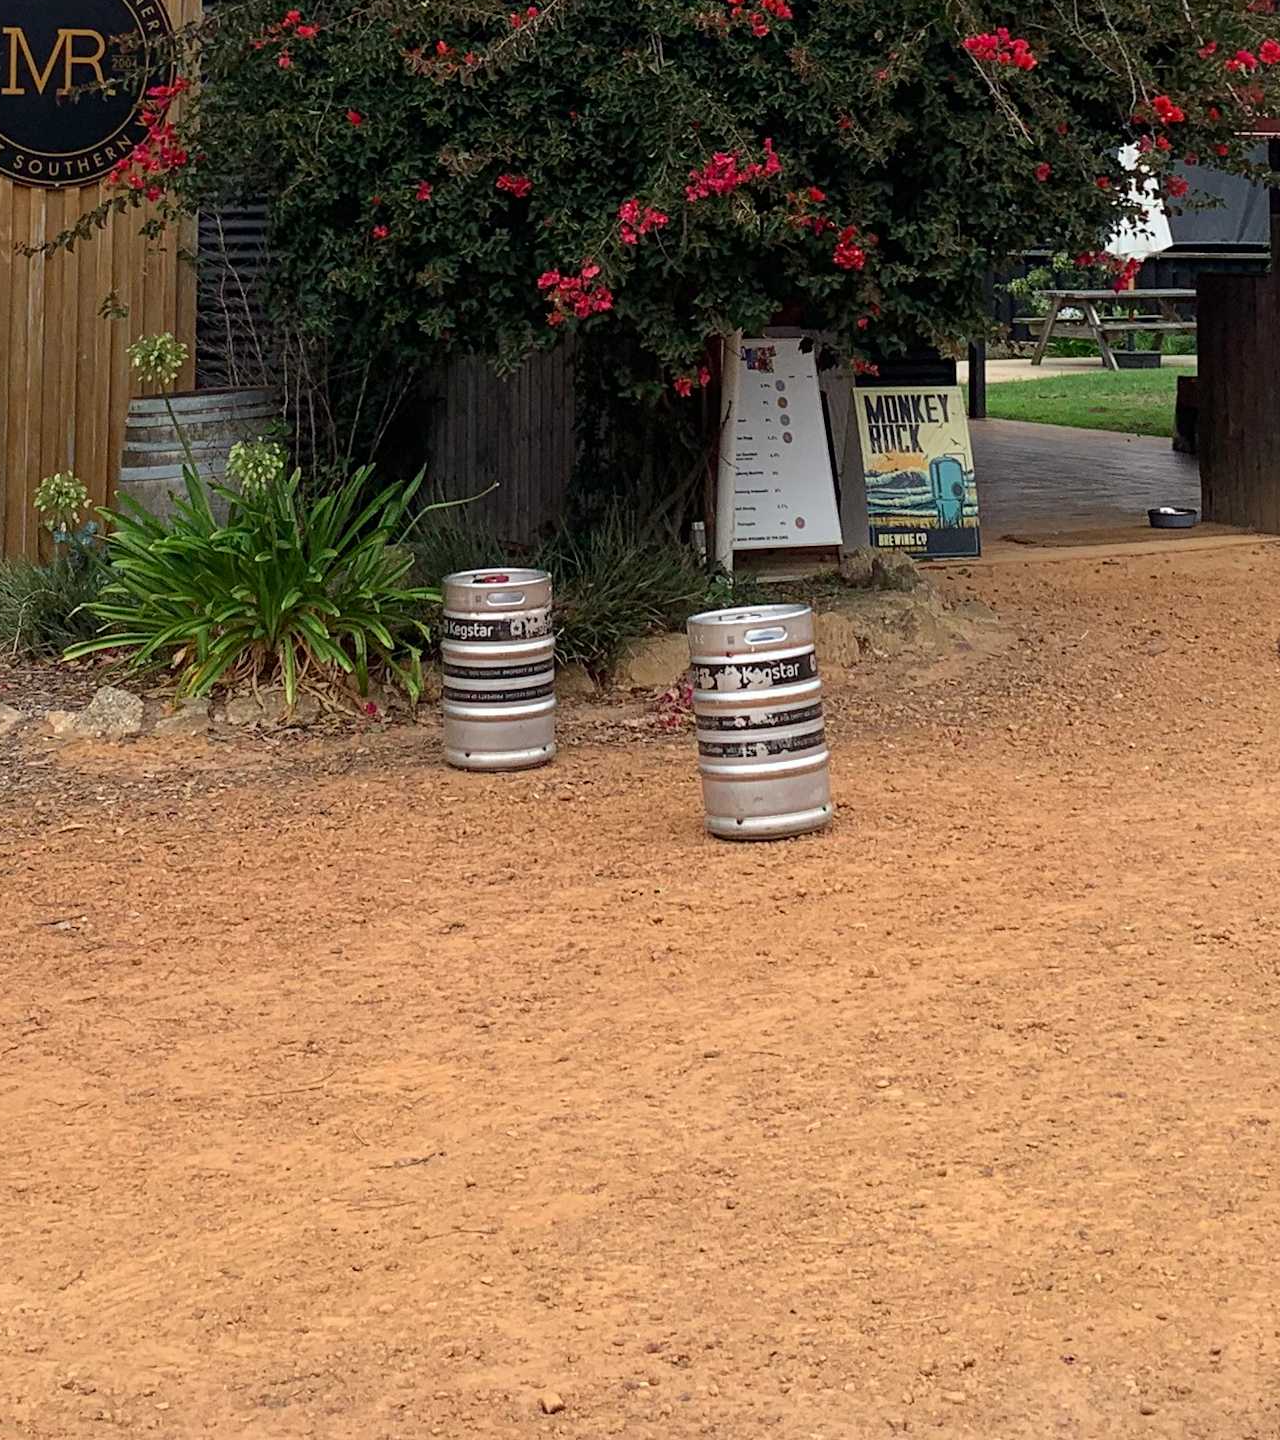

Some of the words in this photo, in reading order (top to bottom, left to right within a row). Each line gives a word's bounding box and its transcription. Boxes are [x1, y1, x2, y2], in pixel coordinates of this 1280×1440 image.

[1, 26, 116, 96] MR
[13, 134, 133, 177] SOUTHERN
[864, 394, 950, 424] MONKEY
[869, 422, 924, 454] ROCK
[878, 533, 915, 546] BREWING
[449, 621, 494, 640] Kegstar
[742, 662, 800, 685] Kgstar
